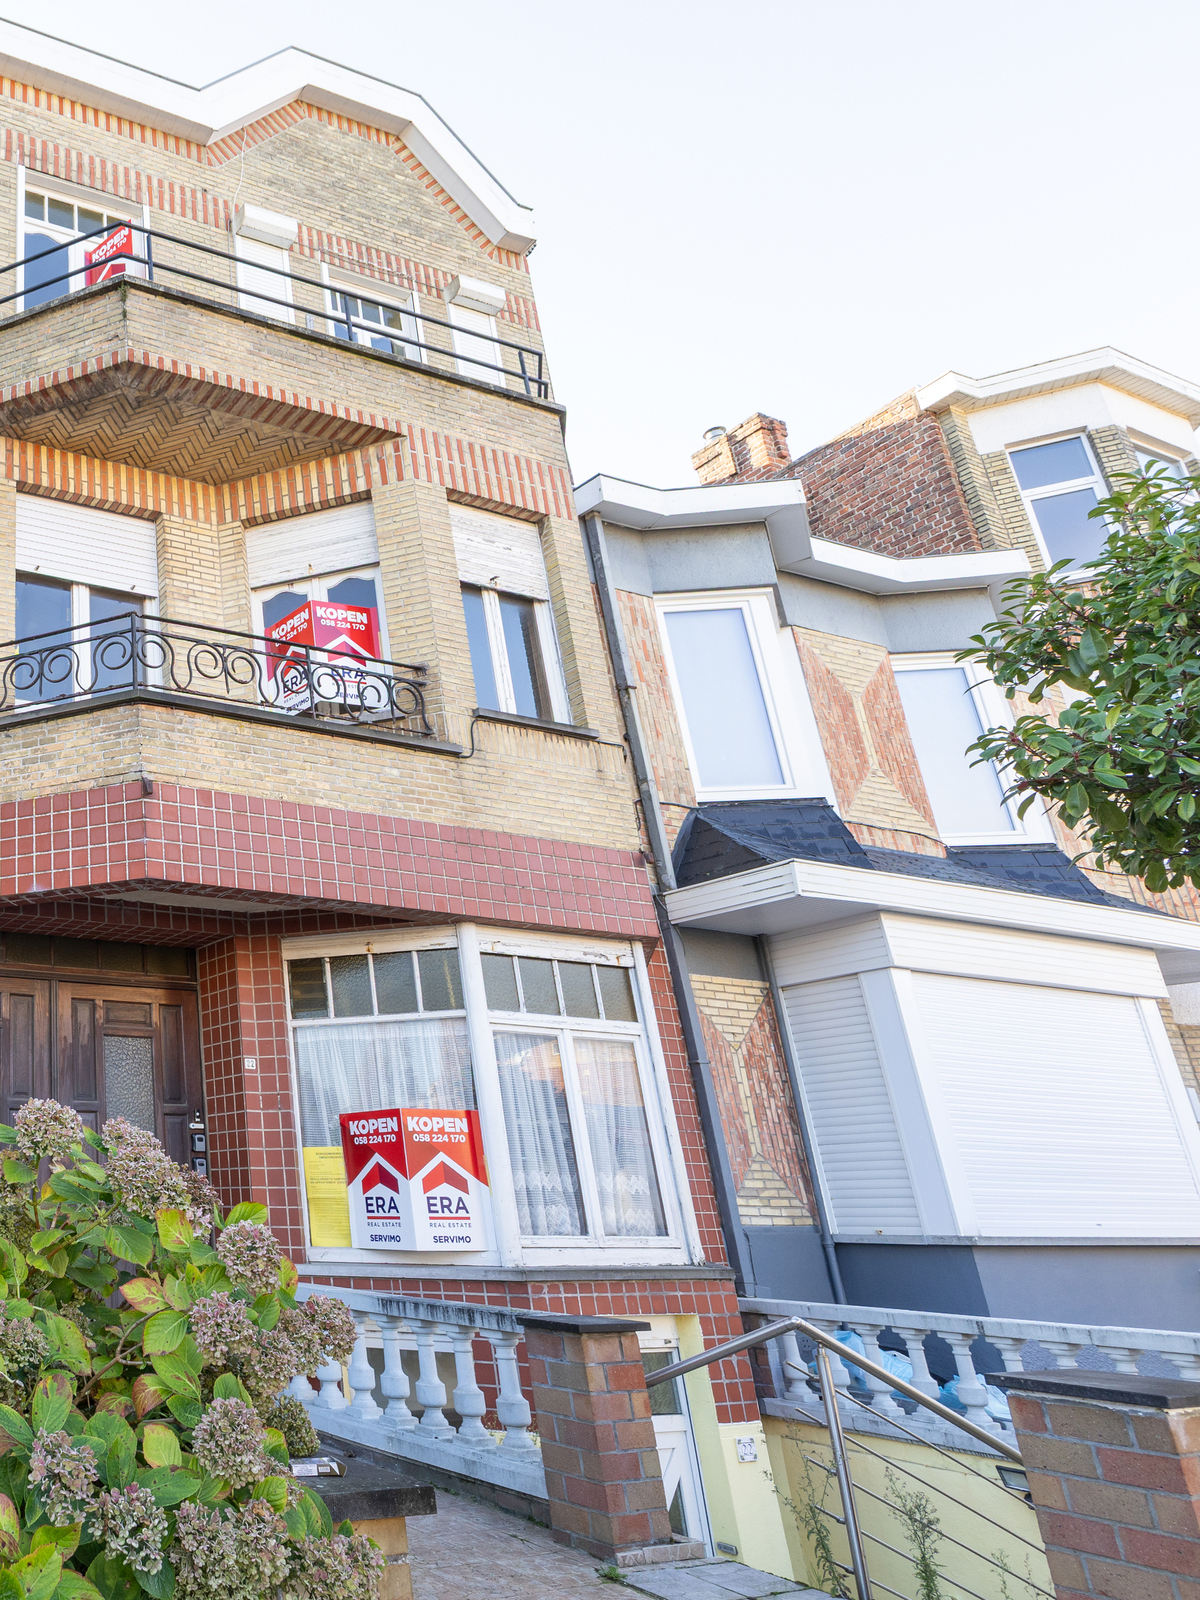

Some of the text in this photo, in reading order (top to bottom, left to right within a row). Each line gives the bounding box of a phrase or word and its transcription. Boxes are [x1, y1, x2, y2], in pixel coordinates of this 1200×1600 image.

[92, 227, 129, 263] KOPEN
[106, 245, 117, 258] 224
[117, 237, 127, 248] 170
[272, 608, 309, 640] KOPEN
[316, 606, 368, 624] KOPEN
[286, 629, 297, 640] 224
[297, 622, 308, 633] 170
[320, 618, 366, 631] 058 224 170
[349, 1117, 399, 1135] KOPEN
[407, 1116, 469, 1133] KOPEN
[354, 1134, 397, 1145] 058 224 170
[413, 1133, 466, 1143] 058 224 170
[365, 1196, 400, 1214] ERA
[426, 1196, 470, 1214] ERA
[369, 1234, 402, 1243] SERVIMO
[433, 1235, 471, 1243] SERVIMO
[741, 1443, 753, 1455] 22
